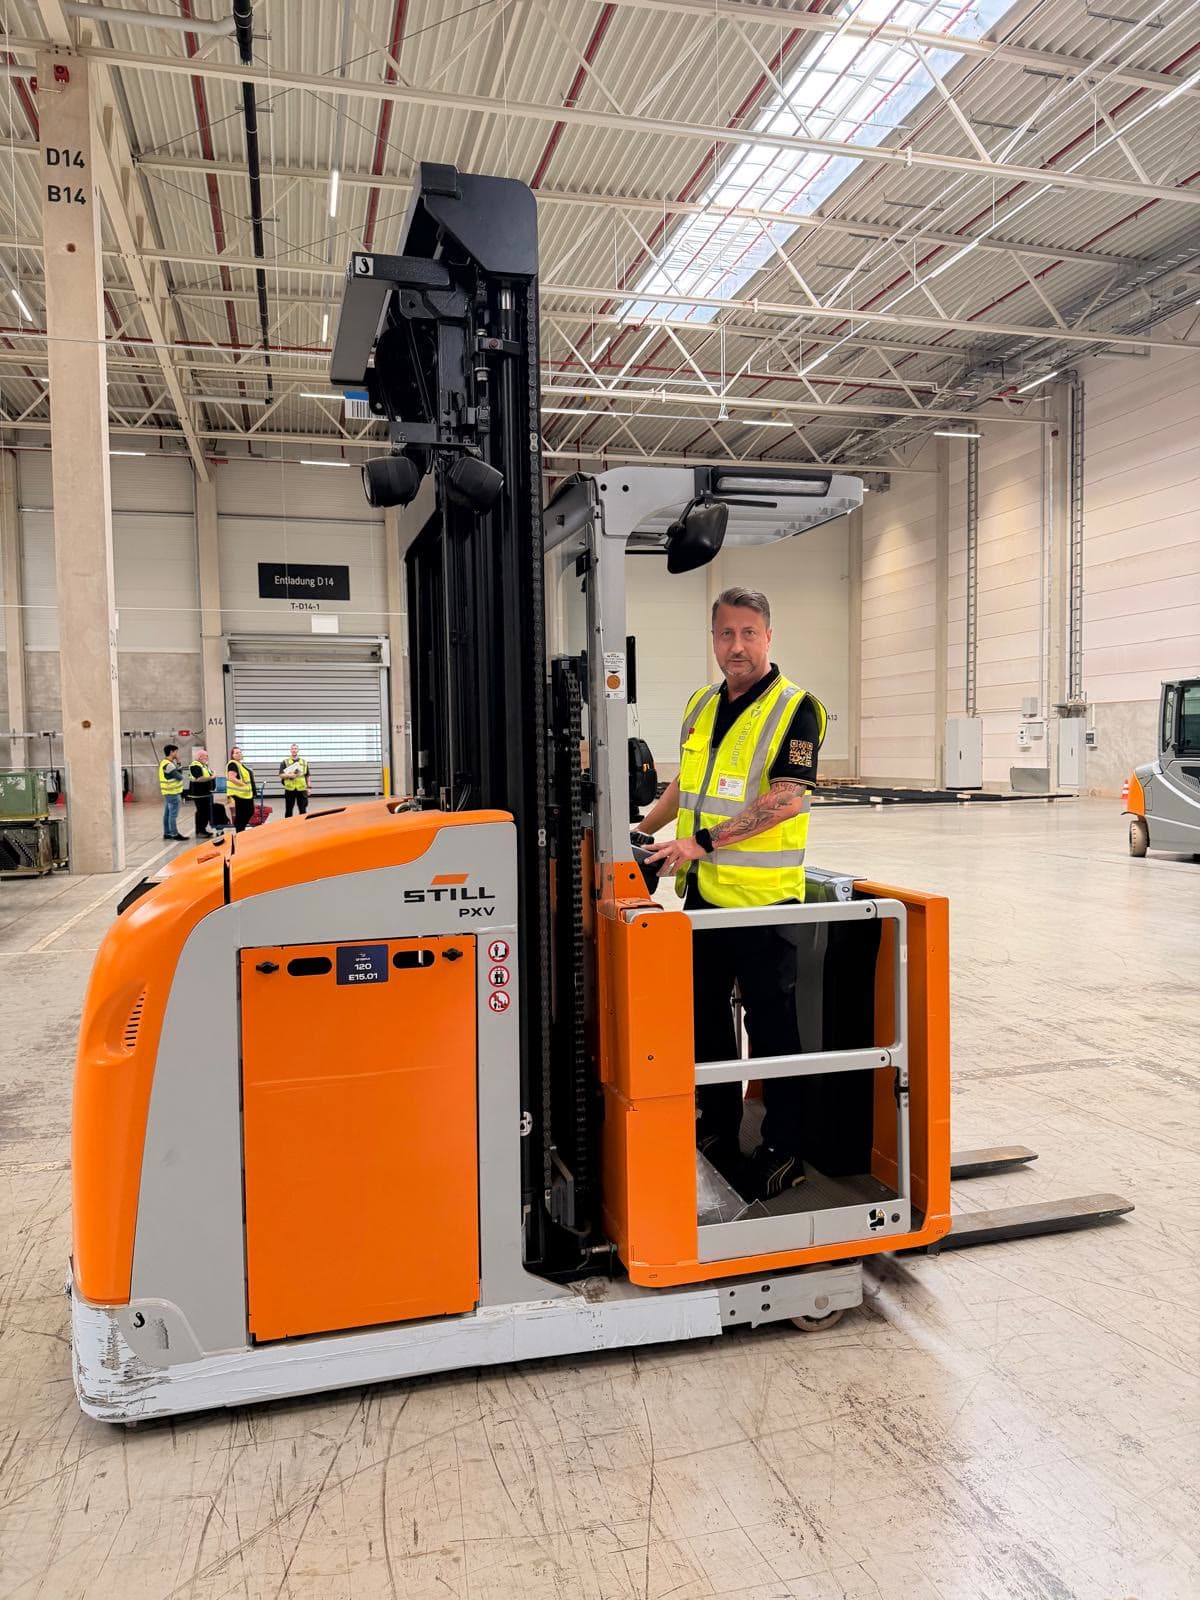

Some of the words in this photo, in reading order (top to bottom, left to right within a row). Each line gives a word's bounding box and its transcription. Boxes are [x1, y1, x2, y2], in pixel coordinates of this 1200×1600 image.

[46, 147, 85, 168] D14
[47, 185, 86, 205] B14
[274, 575, 315, 587] Entladung
[317, 577, 334, 586] D14
[290, 602, 320, 610] T-D14-1
[208, 717, 223, 726] A14
[403, 887, 495, 903] STILL
[459, 906, 495, 918] PXV
[354, 963, 372, 971] 120
[348, 972, 378, 981] E15.01
